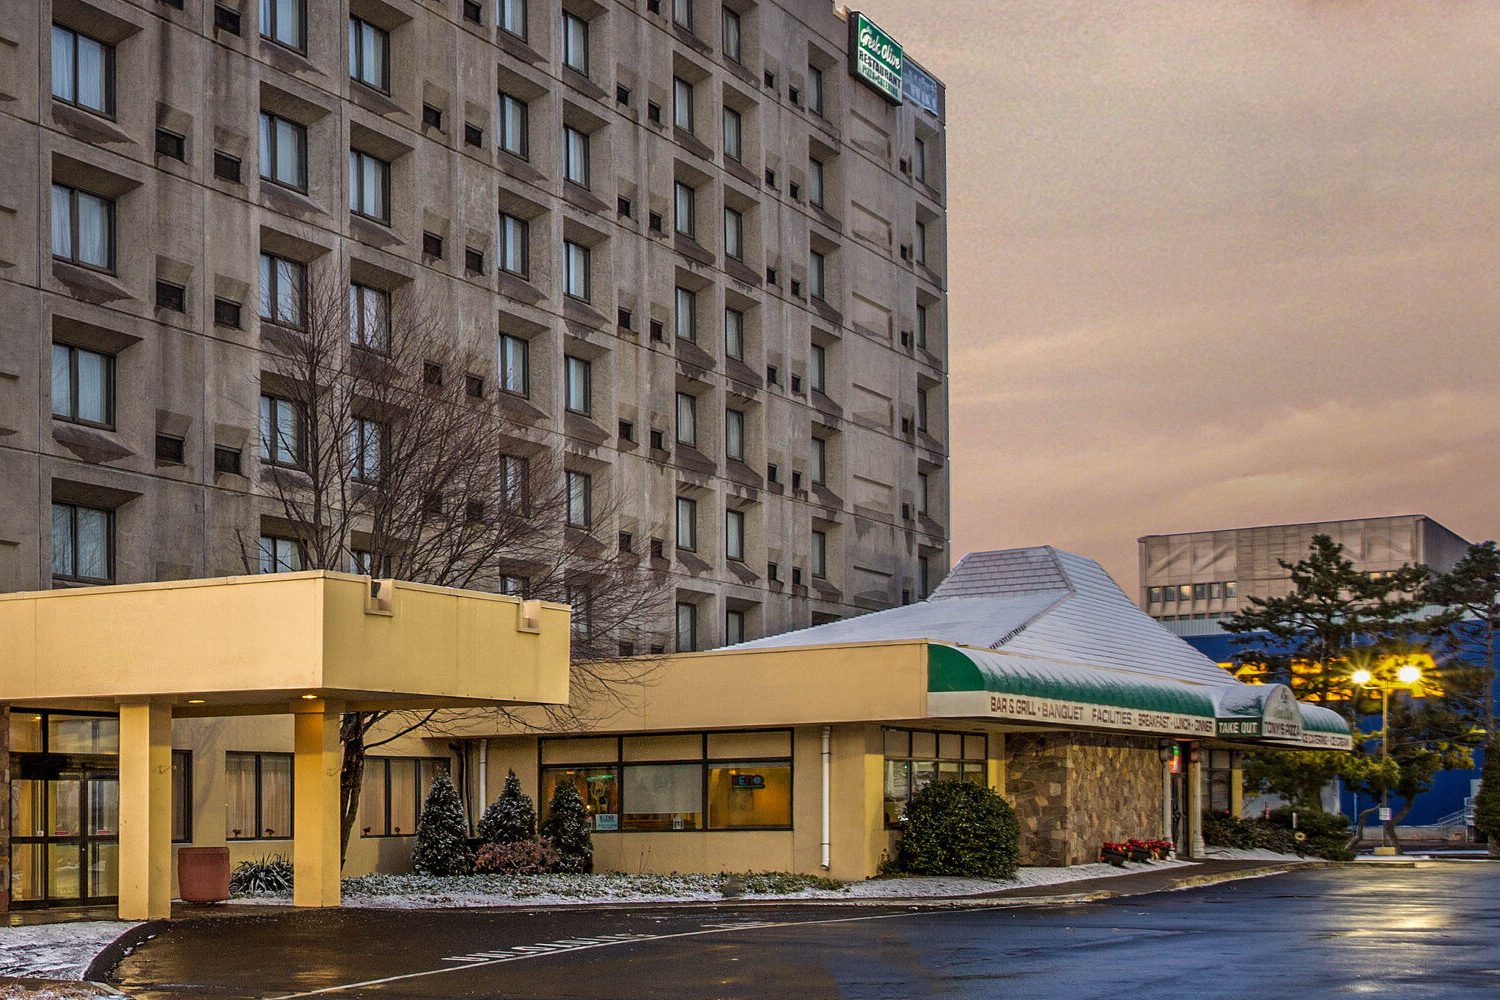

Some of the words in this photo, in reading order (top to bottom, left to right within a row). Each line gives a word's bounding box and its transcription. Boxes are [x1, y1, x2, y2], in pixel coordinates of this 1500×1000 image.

[859, 50, 901, 89] RESTAURANT
[990, 696, 1007, 713] BAR
[1016, 699, 1036, 716] GRILL
[1092, 708, 1132, 725] FACILITIES
[1138, 713, 1170, 729] BREAKFAST
[1218, 722, 1239, 733] TAKE
[1240, 722, 1258, 733] OUT
